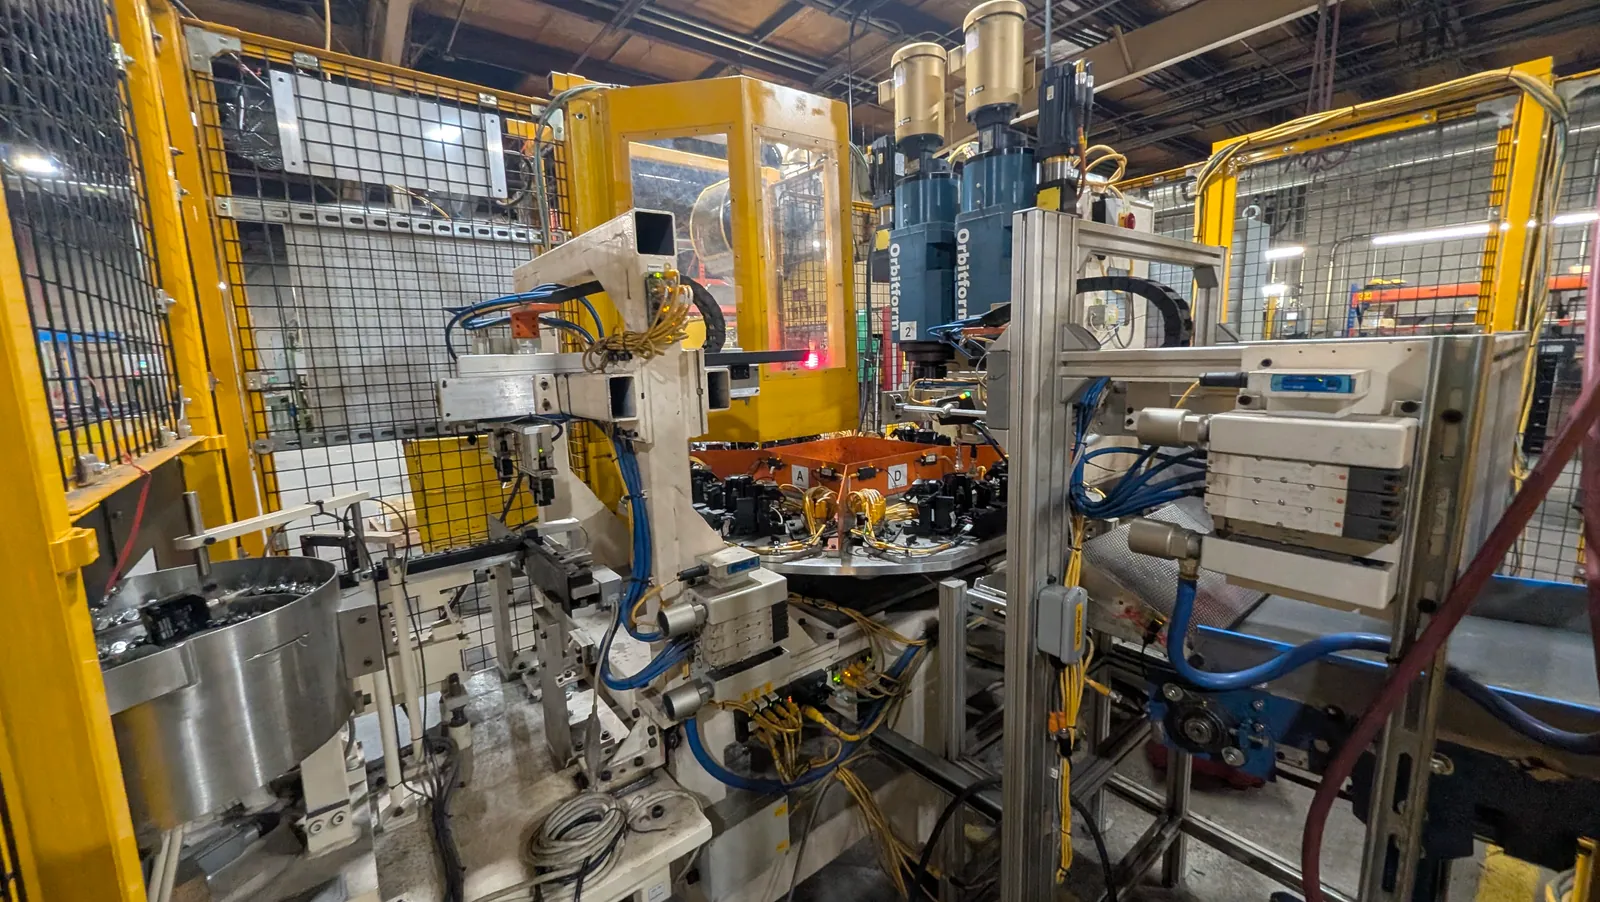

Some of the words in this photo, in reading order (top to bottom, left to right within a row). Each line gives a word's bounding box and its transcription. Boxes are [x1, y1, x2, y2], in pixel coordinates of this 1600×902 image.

[890, 243, 901, 331] Orbitform
[905, 326, 911, 337] 2
[796, 470, 804, 482] A
[894, 470, 902, 482] D
